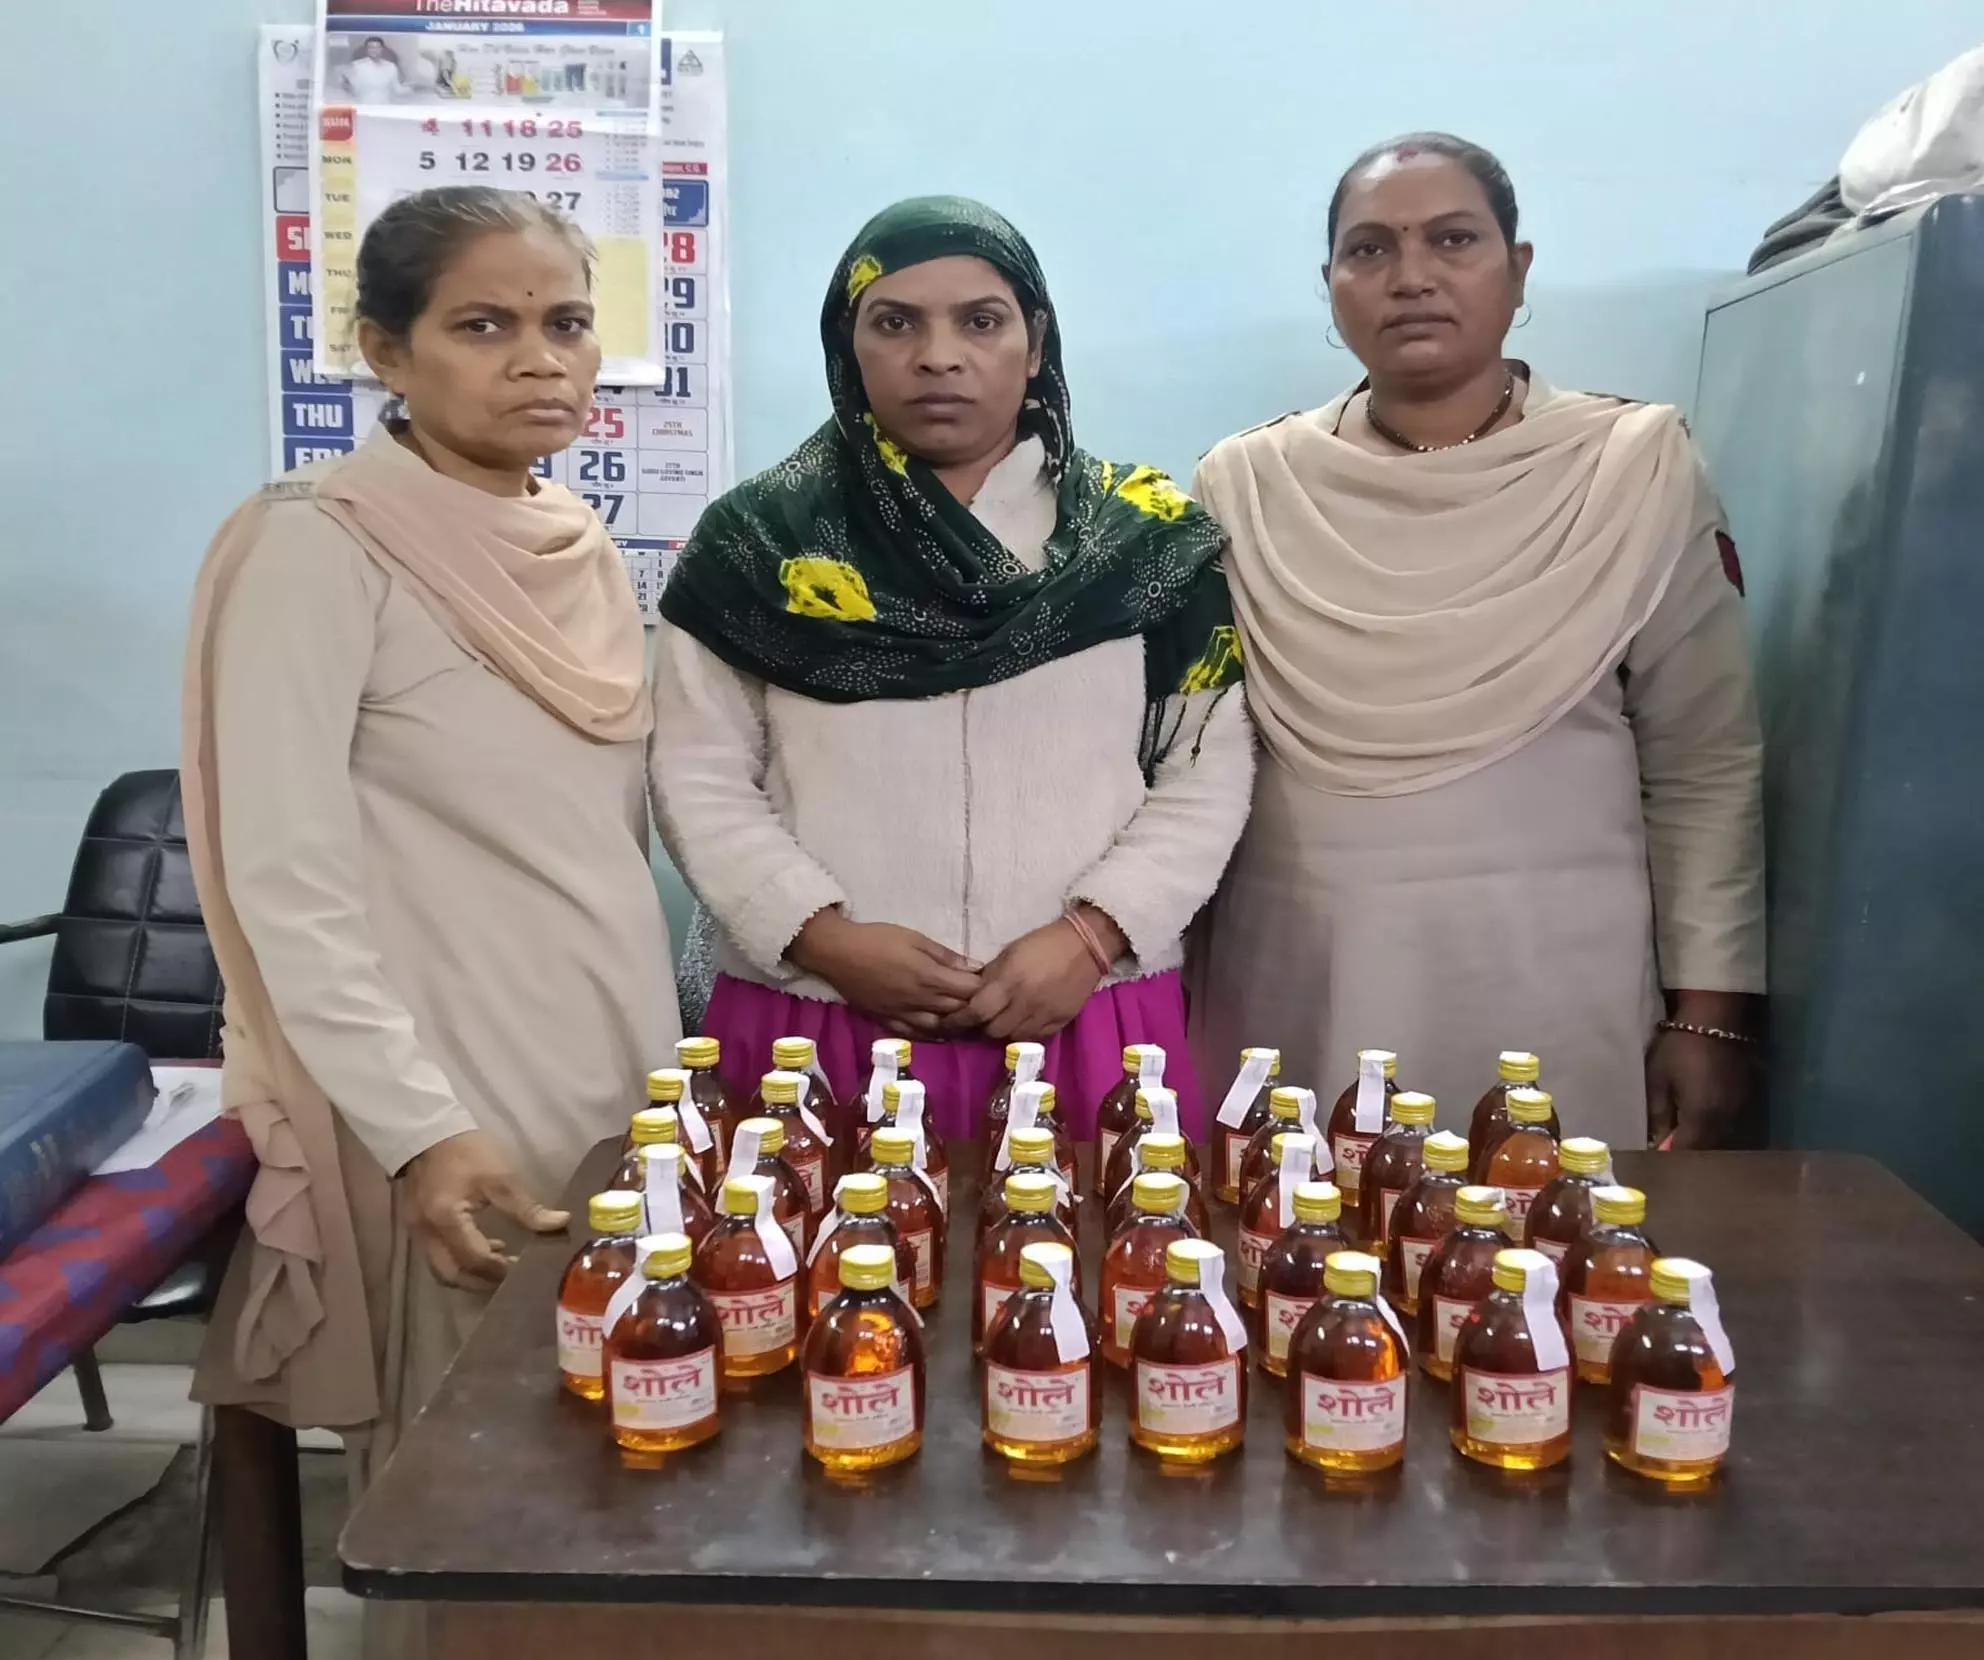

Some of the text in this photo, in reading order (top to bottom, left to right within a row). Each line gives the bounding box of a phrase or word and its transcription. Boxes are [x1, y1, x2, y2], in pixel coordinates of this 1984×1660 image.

[425, 21, 489, 32] JANUARY
[461, 118, 493, 138] 11
[503, 119, 537, 138] 18
[548, 120, 584, 139] 25
[322, 151, 582, 172] MON 5 12 19 26
[325, 193, 351, 202] TUE
[546, 191, 582, 210] 27
[324, 231, 352, 240] WED
[293, 403, 624, 438] THU 25
[580, 451, 625, 482] 26
[623, 1364, 704, 1397] शोले
[996, 1377, 1076, 1408] शोले
[1148, 1370, 1227, 1401] शोले
[820, 1382, 900, 1416] शोले
[1316, 1386, 1397, 1418] शोले
[1476, 1381, 1558, 1412] शोले
[1653, 1398, 1729, 1428] शोले
